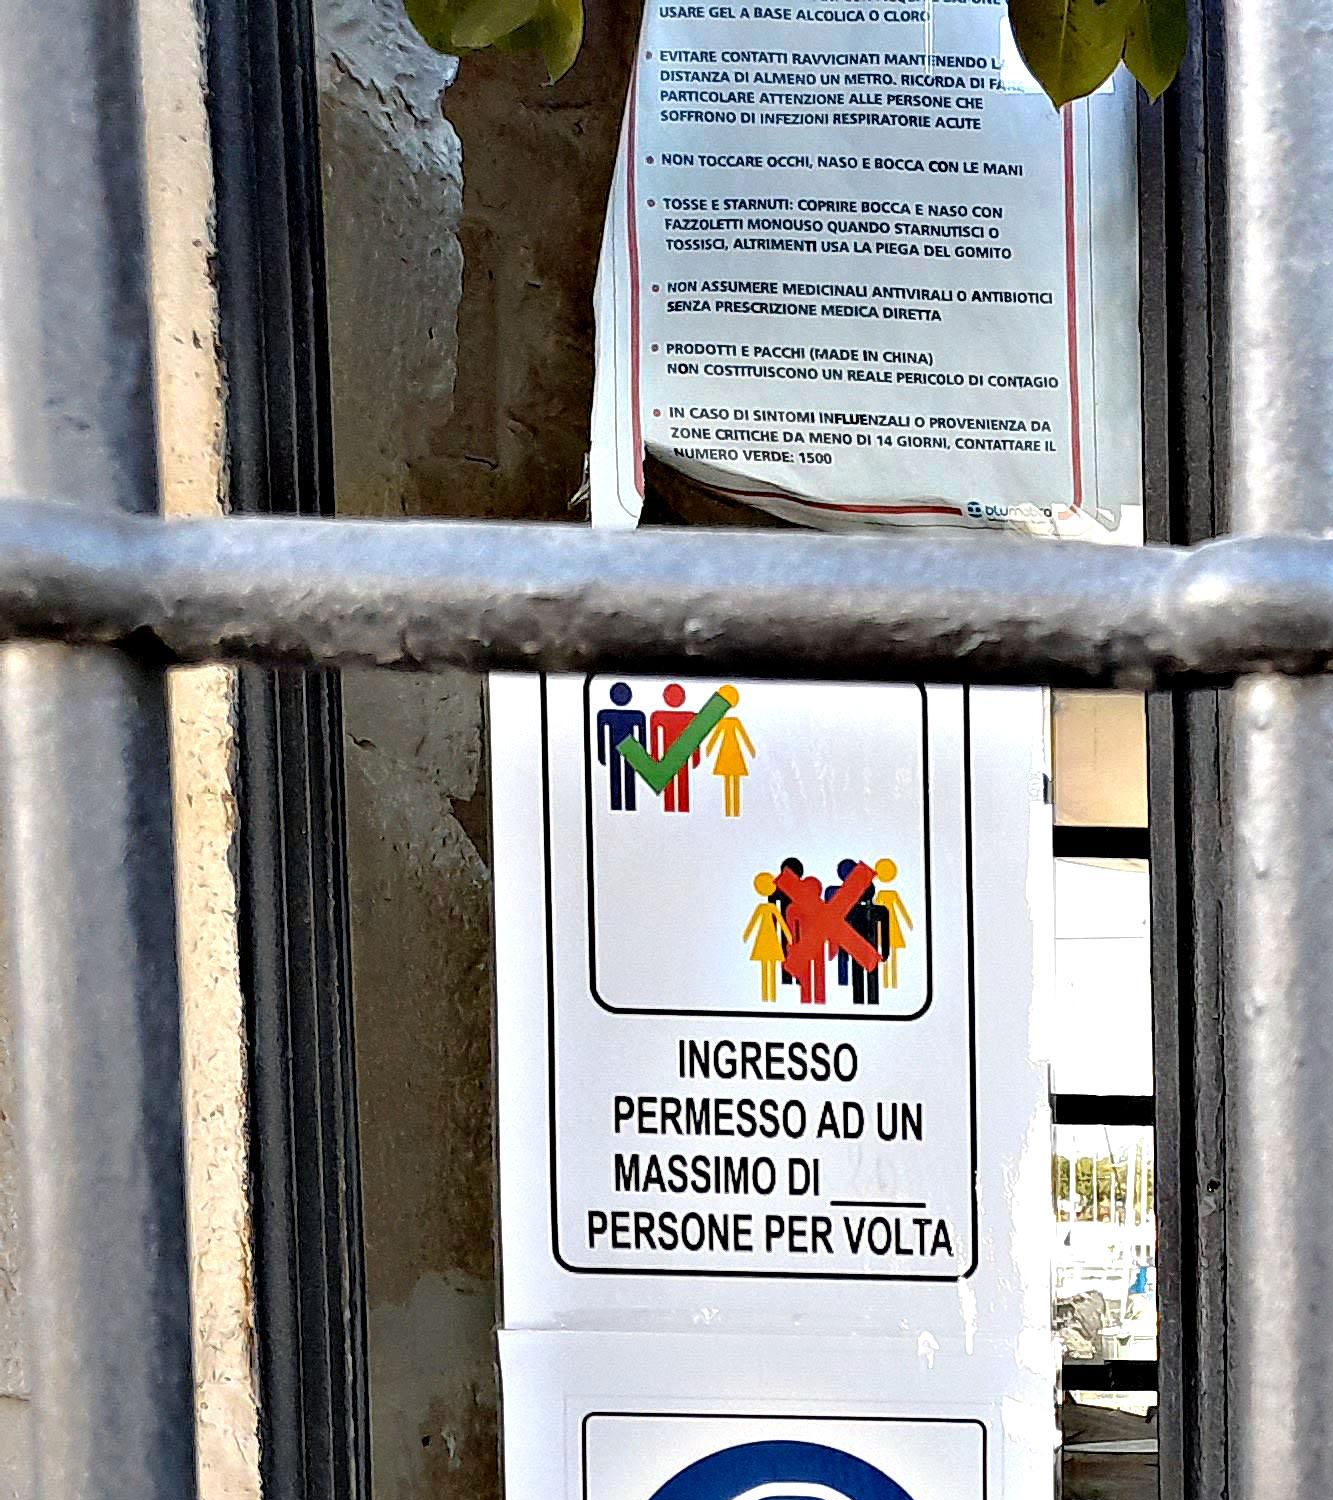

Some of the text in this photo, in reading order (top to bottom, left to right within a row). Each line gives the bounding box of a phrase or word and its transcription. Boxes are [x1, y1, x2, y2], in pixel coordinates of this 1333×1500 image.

[660, 6, 879, 22] USARE GEL A BASE ALCOLICA O
[660, 50, 880, 65] EVITARE CONTATTI RAVVICINATI
[661, 70, 730, 83] DISTANZA
[735, 72, 749, 83] DI
[753, 71, 816, 85] ALMENO
[820, 73, 840, 86] UN
[845, 73, 897, 85] METRO.
[970, 77, 984, 88] DI
[661, 90, 983, 110] PARTICOLARE ATTENZIONE ALLE PERSONE CHE
[661, 109, 981, 130] SOFFRONO DI INFEZIONI RESPIRATORIE ACUTE
[662, 153, 1022, 177] NON TOCCARE OCCHI, NASO E BOCCA CON LE MANI
[663, 197, 1002, 219] TOSSE E STARNUTI: COPRIRE BOCCA E NASO CON
[665, 218, 999, 239] FAZZOLETTI MONOUSO QUANDO STARNUTISCI O
[733, 238, 817, 253] ALTRIMENTI
[821, 241, 849, 253] USA
[854, 242, 872, 254] LA
[876, 241, 919, 256] PIEGA
[924, 244, 950, 258] DEL
[955, 245, 1011, 260] GOMITO
[668, 280, 1052, 305] NON ASSUMERE MEDICINALI ANTIVIRALI O ANTIBIOTICI
[668, 300, 941, 322] SENZA PRESCRIZIONE MEDICA DIRETTA
[667, 343, 736, 357] PRODOTTI
[742, 345, 749, 357] E
[754, 346, 805, 360] PACCHI
[863, 349, 878, 362] IN
[883, 351, 933, 366] CHINA)
[668, 362, 698, 375] NON
[822, 369, 842, 381] UN
[847, 369, 892, 384] REALE
[897, 372, 964, 386] PERICOLO
[969, 374, 983, 387] DI
[988, 375, 1058, 389] CONTAGIO
[670, 407, 1051, 432] IN CASO DI SINTOMI INFLUENZALI O PROVENIENZA DA
[671, 427, 711, 440] ZONE
[715, 428, 779, 442] CRITICHE
[783, 431, 804, 443] DA
[809, 431, 852, 446] MENO
[857, 433, 871, 446] DI
[877, 436, 892, 447] 14
[955, 437, 1040, 452] CONTATTARE
[1045, 440, 1056, 451] IL
[743, 449, 832, 464] VERDE: 1500
[679, 1039, 857, 1082] INGRESSO
[615, 1095, 922, 1142] PERMESSO AD UN
[615, 1153, 819, 1196] MASSIMO DI
[588, 1210, 954, 1258] PERSONE PER VOLTA
